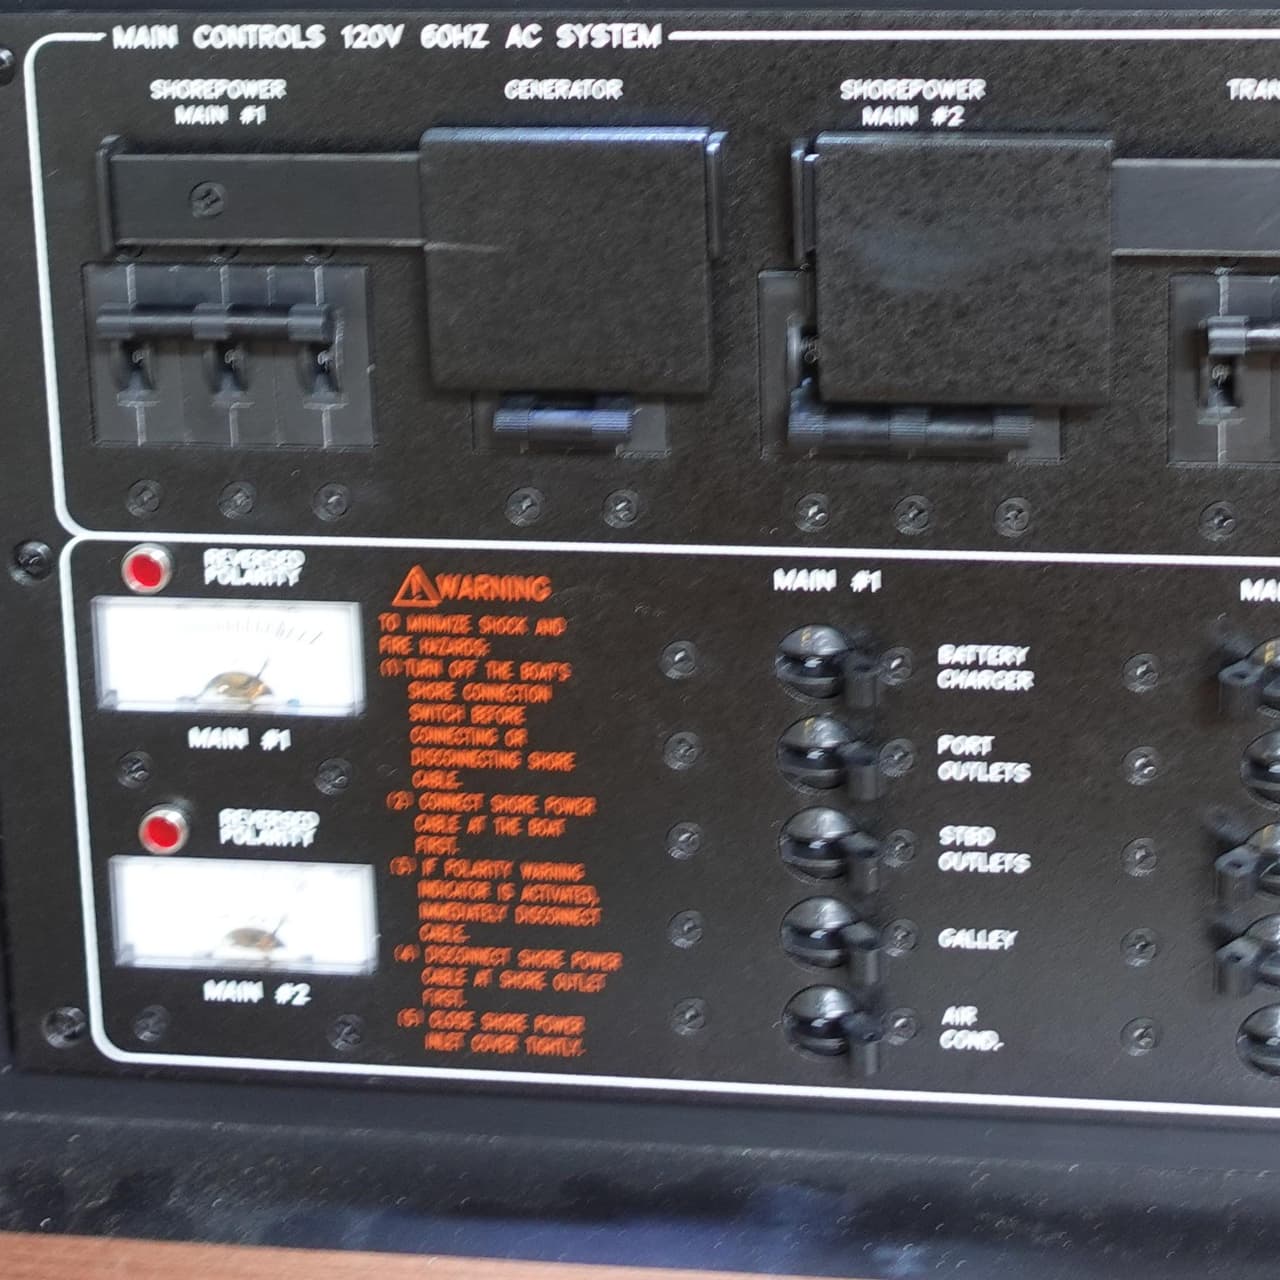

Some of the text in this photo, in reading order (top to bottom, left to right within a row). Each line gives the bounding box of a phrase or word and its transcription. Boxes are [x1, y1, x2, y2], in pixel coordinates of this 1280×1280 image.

[112, 23, 662, 49] MAIN CONTROLS 120V 60HZ AC SYSTEM
[150, 79, 287, 100] SHOREPOWER
[504, 79, 623, 100] GENERATOR
[840, 79, 986, 100] SHOREPOWER
[174, 105, 266, 125] MAIN #1
[862, 105, 965, 127] MAIN #2
[435, 572, 553, 603] WARNING
[773, 568, 881, 592] MAIN #1
[379, 612, 402, 633] TO
[938, 644, 1030, 666] BATTERY
[937, 669, 1034, 691] CHARGER
[188, 726, 291, 751] MAIN #1
[937, 735, 995, 756] PORT
[938, 761, 1031, 783] OUTLETS
[939, 825, 996, 847] STBD
[938, 851, 1031, 874] OUTLETS
[938, 928, 1019, 950] GALLEY
[203, 980, 311, 1006] MAIN #2
[941, 1006, 978, 1026] AIR
